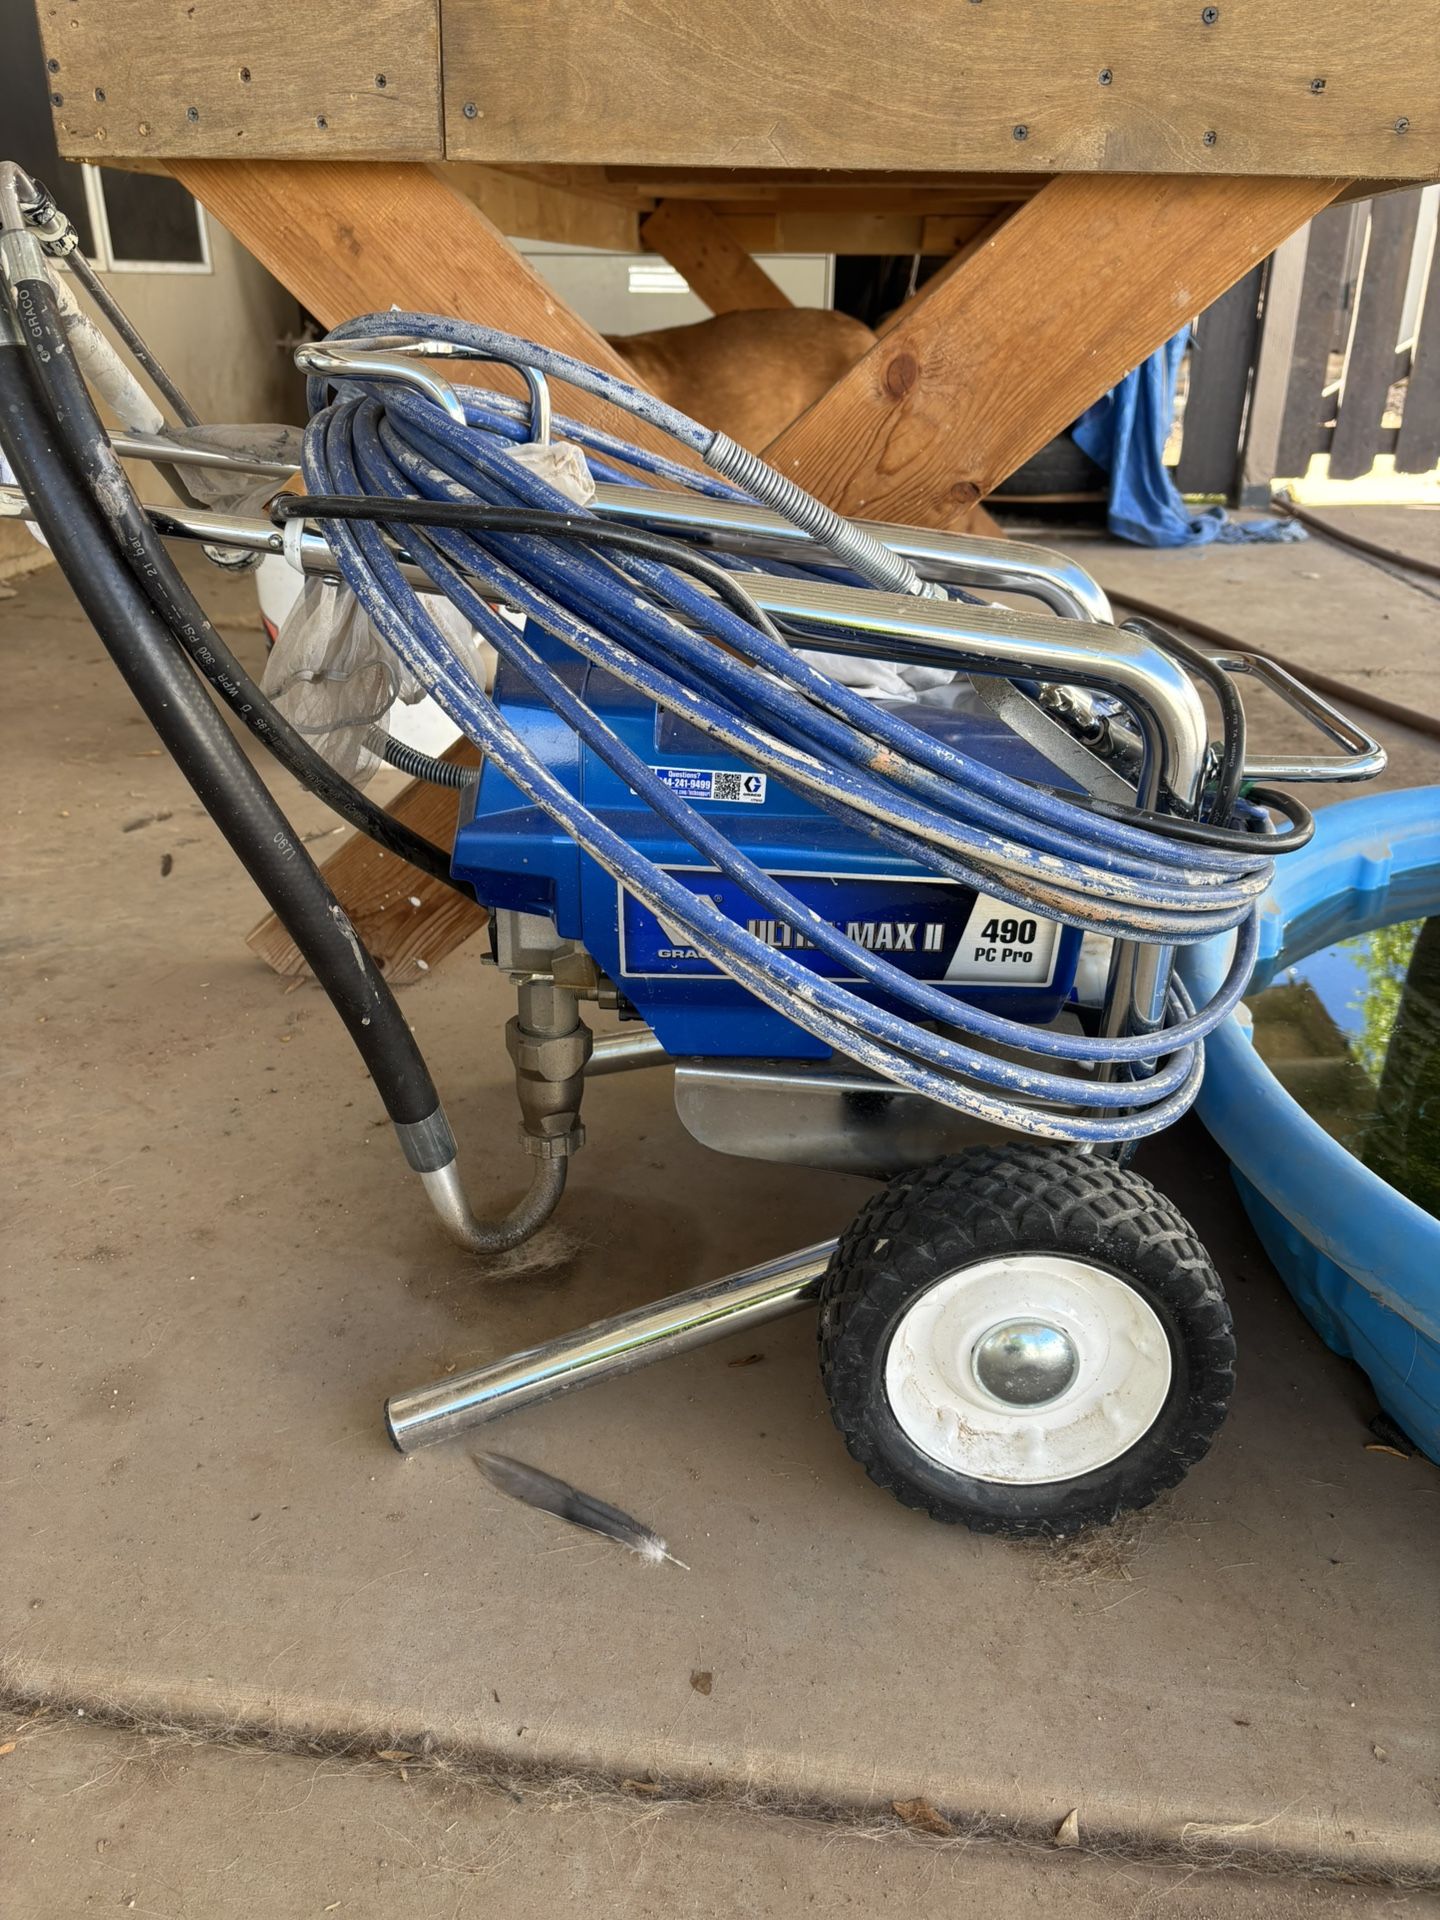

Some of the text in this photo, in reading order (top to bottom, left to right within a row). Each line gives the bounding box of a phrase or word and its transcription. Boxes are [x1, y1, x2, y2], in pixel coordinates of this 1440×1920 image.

[19, 290, 43, 337] GRACO
[129, 536, 145, 557] bar
[143, 562, 158, 577] 21
[182, 623, 200, 643] PSI
[199, 646, 216, 665] 300
[217, 673, 239, 697] WPR
[668, 770, 701, 779] Questions?
[273, 831, 296, 861] 0671
[847, 922, 917, 951] MAX
[922, 923, 945, 952] II
[981, 919, 1037, 944] 490
[974, 948, 1033, 963] PC Pro
